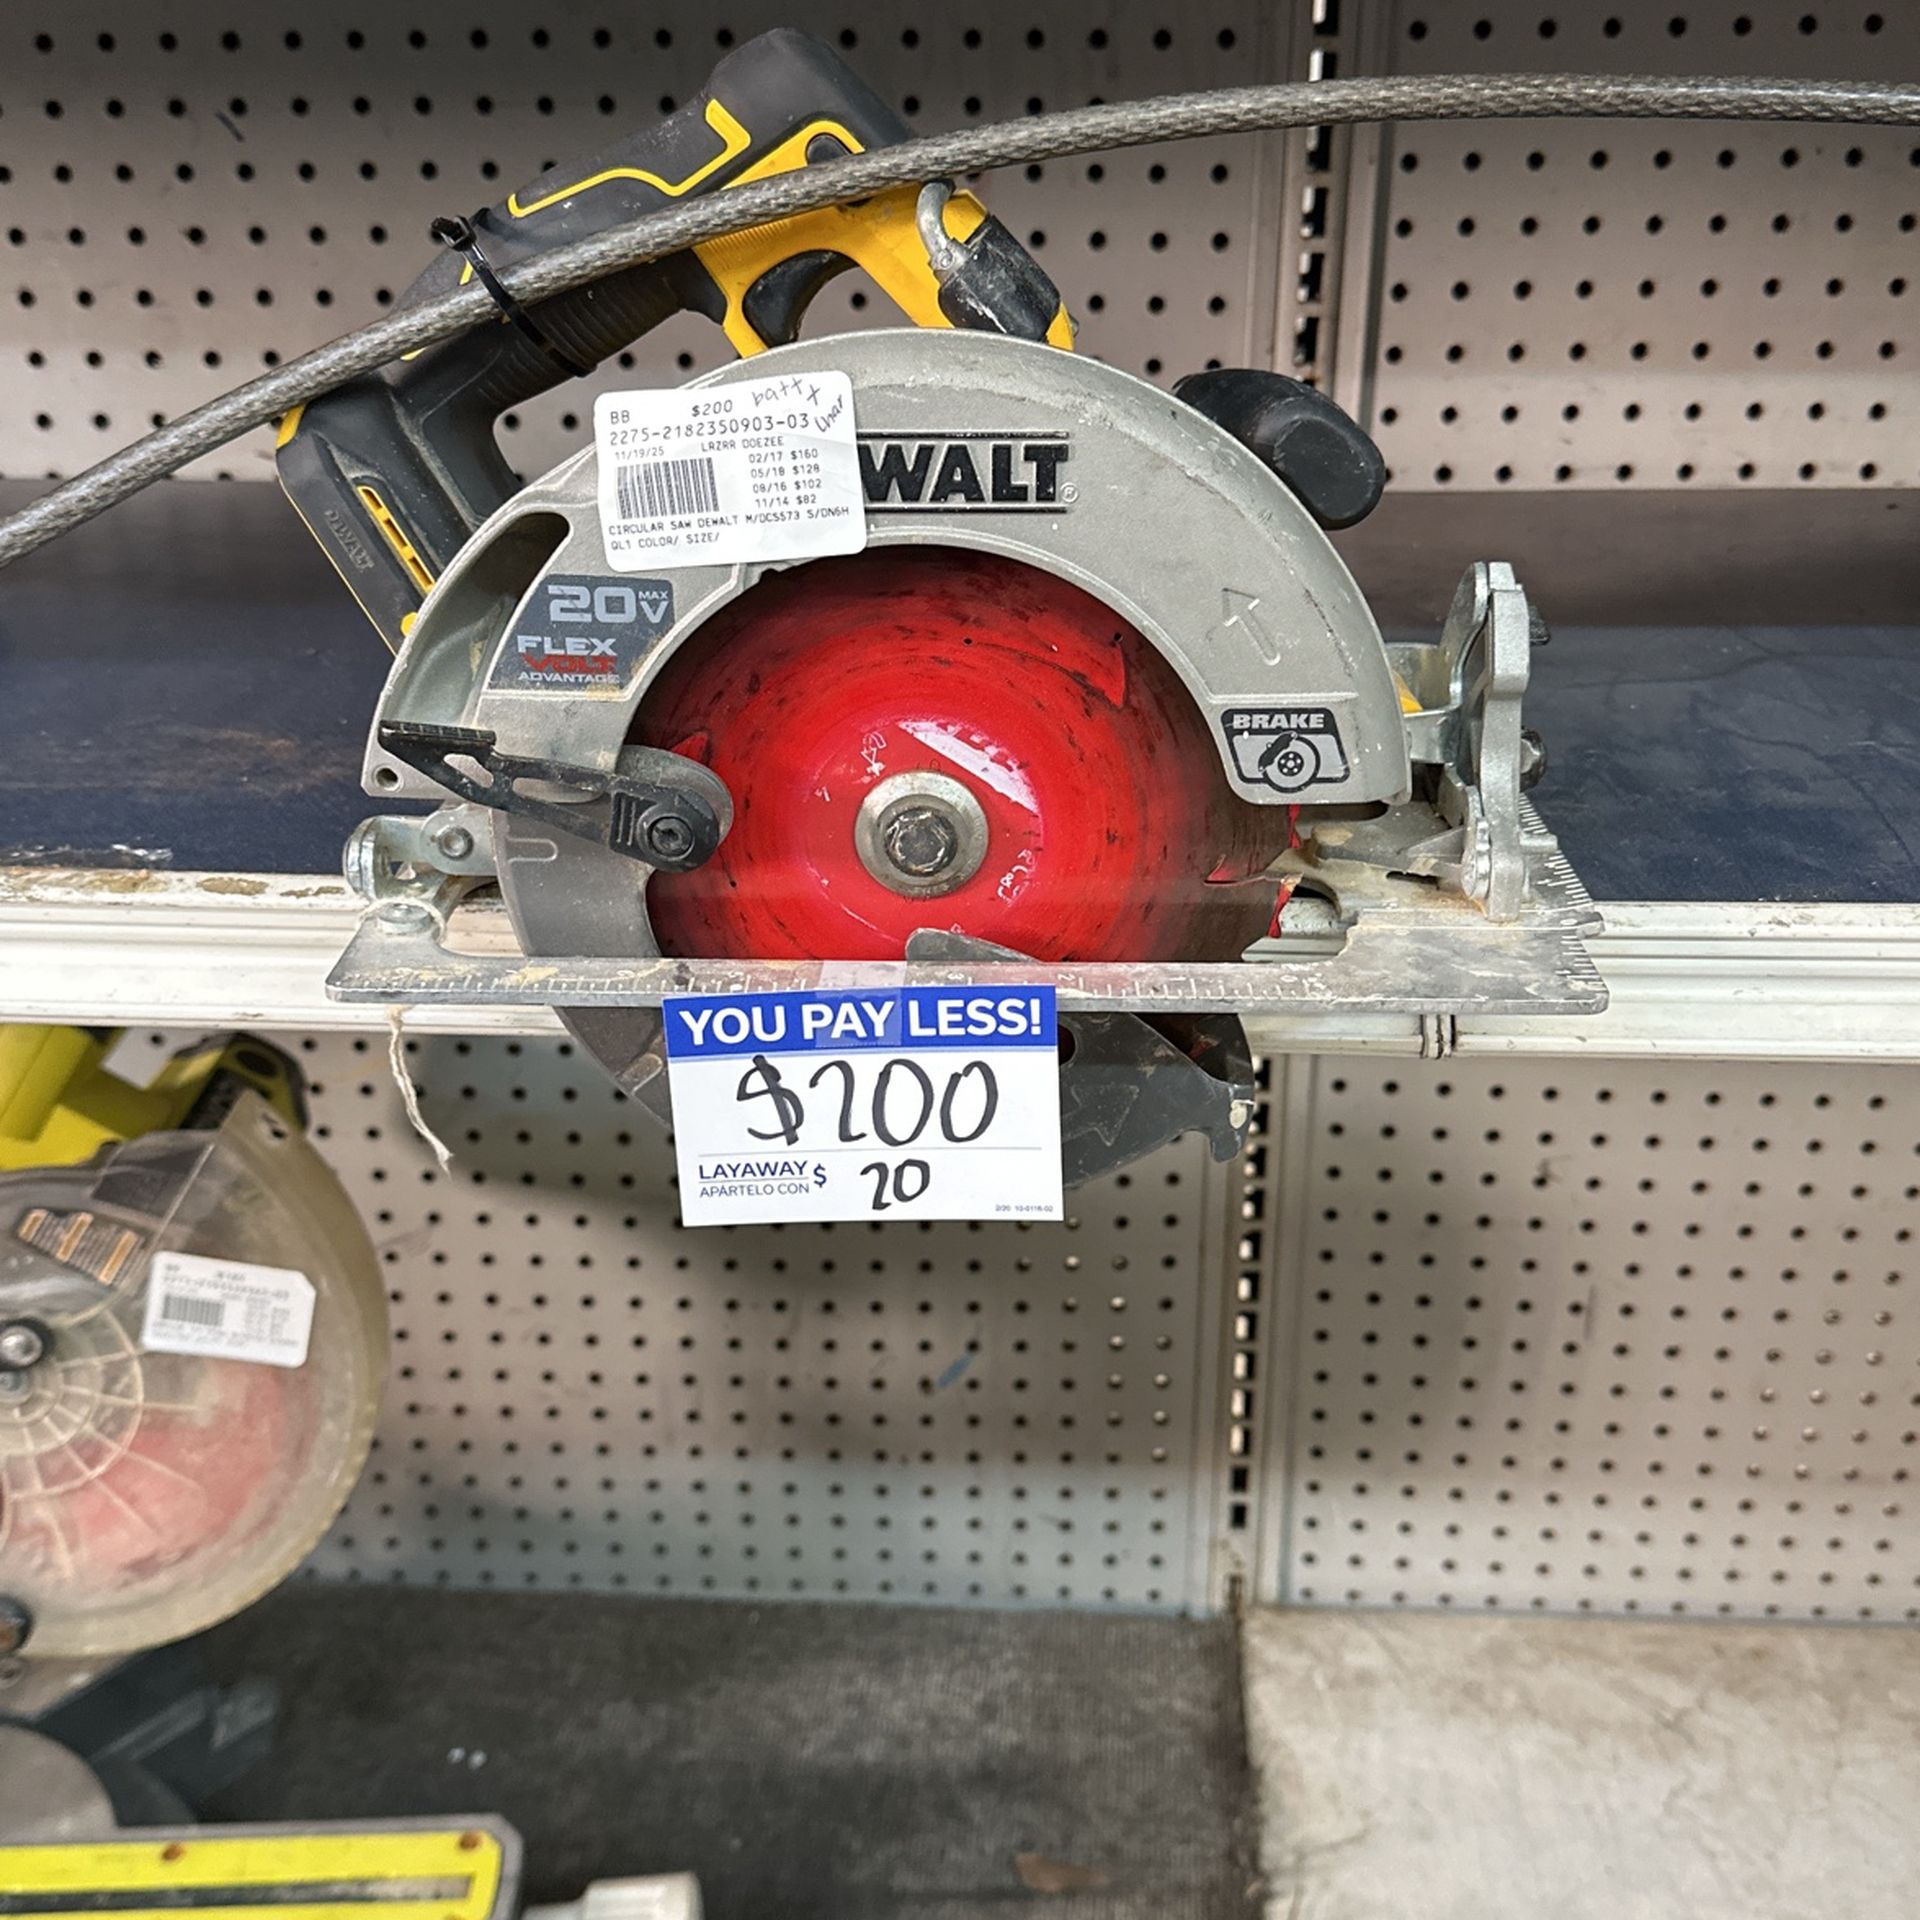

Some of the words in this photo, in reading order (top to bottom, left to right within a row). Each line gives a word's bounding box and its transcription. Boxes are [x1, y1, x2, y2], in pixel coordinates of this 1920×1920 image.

[610, 409, 630, 425] BB
[691, 399, 733, 418] $200
[609, 413, 809, 446] 2275-2182350903-03
[615, 446, 664, 460] 11/19/25
[748, 451, 783, 463] 02/17
[790, 448, 819, 460] $160
[750, 466, 785, 479] 05/18
[792, 463, 821, 475] $128
[856, 443, 1069, 502] WALT
[752, 481, 787, 494] 08/16
[794, 478, 822, 490] $102
[755, 496, 789, 508] 11/14
[796, 493, 817, 505] $82
[608, 521, 664, 536] CIRCULAR
[670, 520, 692, 531] SAW
[697, 515, 738, 528] DEWALT
[638, 535, 679, 548] COLOR/
[685, 532, 720, 544] SIZE/
[638, 591, 668, 600] MAX
[517, 635, 617, 656] FLEX
[521, 655, 617, 672] VOLT
[518, 671, 620, 684] ADVANTAGE
[1233, 713, 1325, 729] BRAKE
[678, 1005, 787, 1045] YOU
[802, 1001, 895, 1040] PAY
[908, 998, 1042, 1038] LESS!
[736, 1054, 999, 1147] $200
[699, 1160, 808, 1180] LAYAWAY
[813, 1163, 827, 1188] $
[777, 1183, 810, 1196] CON
[860, 1158, 931, 1211] 20
